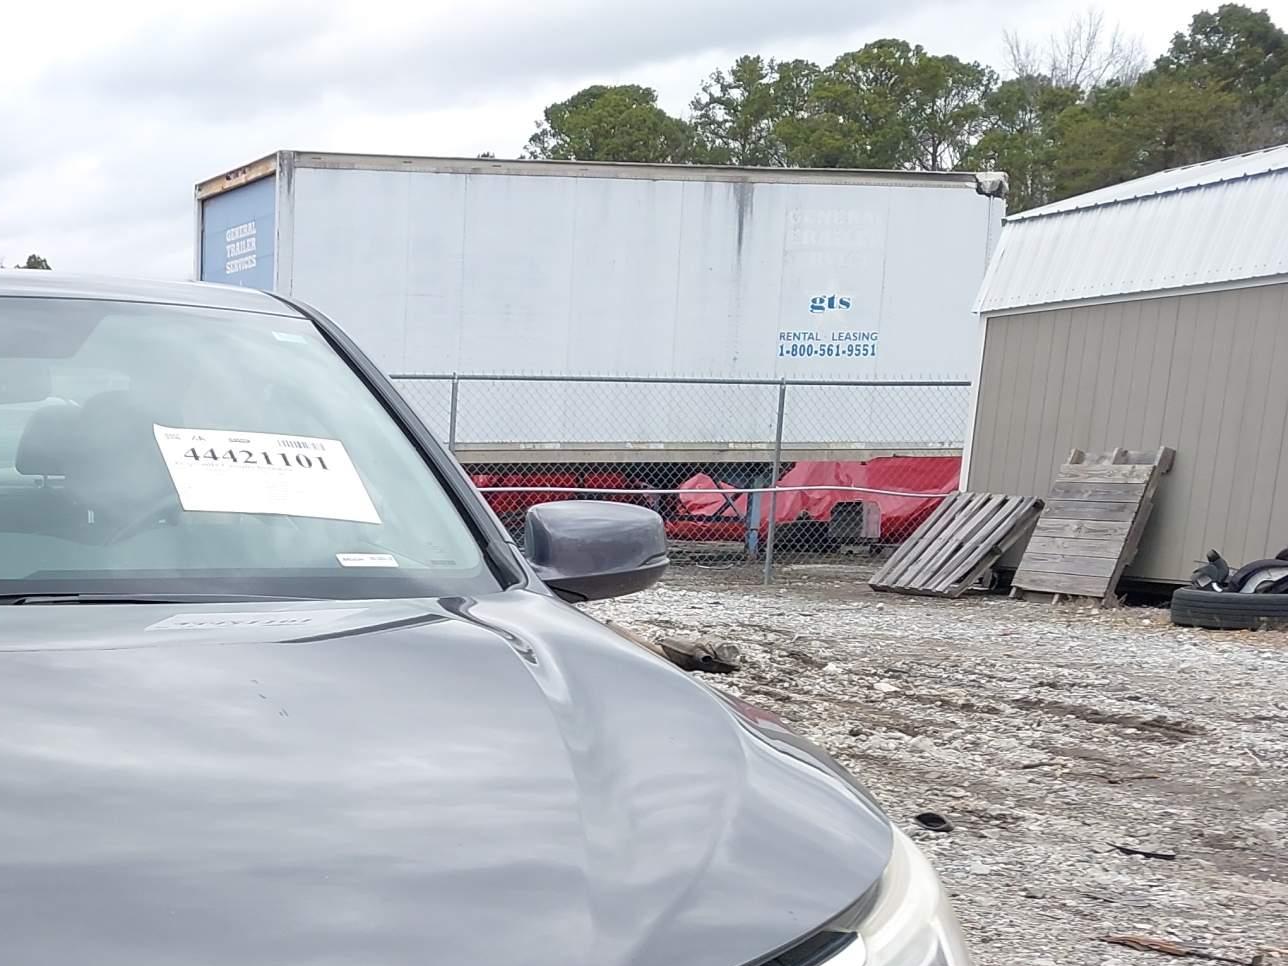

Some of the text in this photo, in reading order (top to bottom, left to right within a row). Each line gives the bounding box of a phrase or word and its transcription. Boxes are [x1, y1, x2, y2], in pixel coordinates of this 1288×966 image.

[226, 238, 256, 258] TRAILER
[809, 294, 851, 314] gts
[779, 332, 878, 341] RENTAL LEASING
[779, 344, 876, 357] 1-800-561-9551
[183, 447, 329, 471] 44421101
